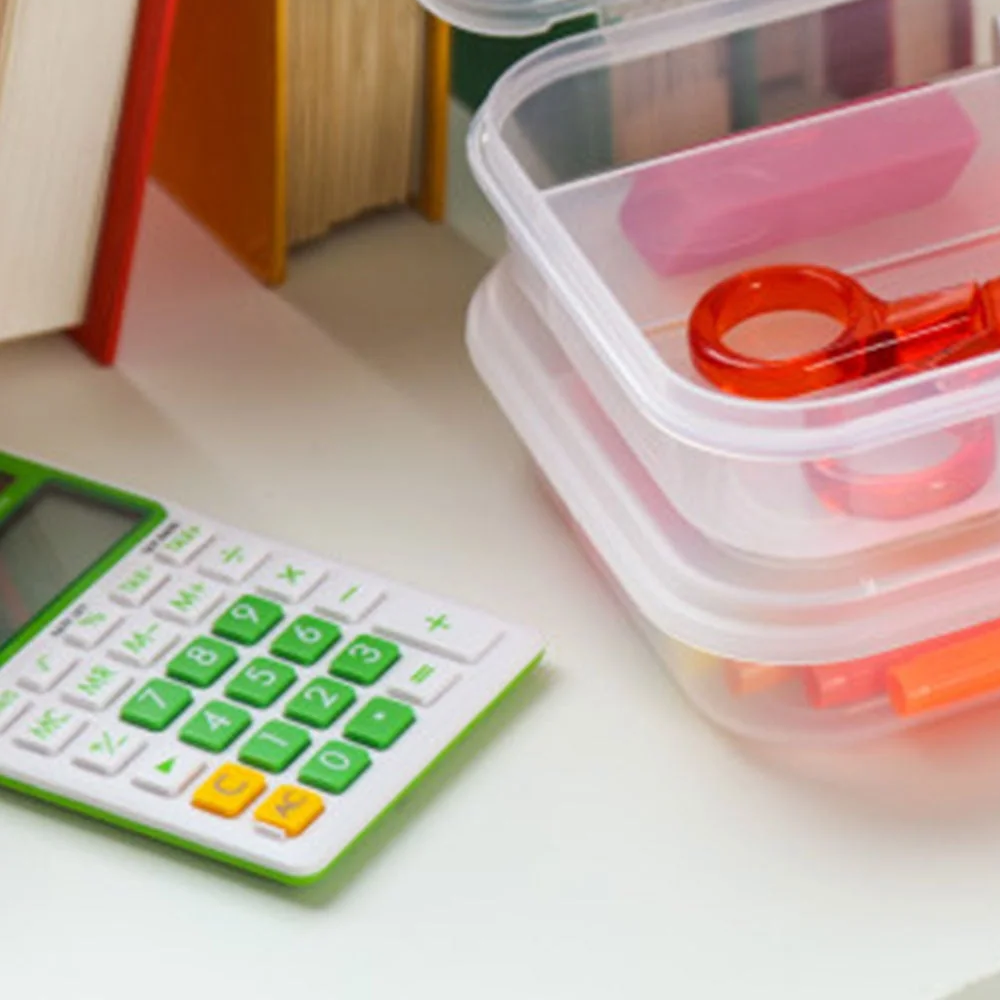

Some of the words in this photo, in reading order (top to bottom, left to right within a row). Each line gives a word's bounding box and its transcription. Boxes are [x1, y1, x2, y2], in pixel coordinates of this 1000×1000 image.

[230, 603, 261, 624] 9
[293, 624, 322, 644] 6
[188, 646, 218, 666] 8
[352, 644, 382, 664] 3
[246, 666, 277, 687] 5
[137, 688, 166, 709] 7
[304, 685, 340, 709] 2
[202, 709, 232, 732] 4
[259, 731, 289, 748] 1
[320, 750, 350, 771] 0
[213, 773, 250, 796] C
[274, 791, 308, 819] AC
